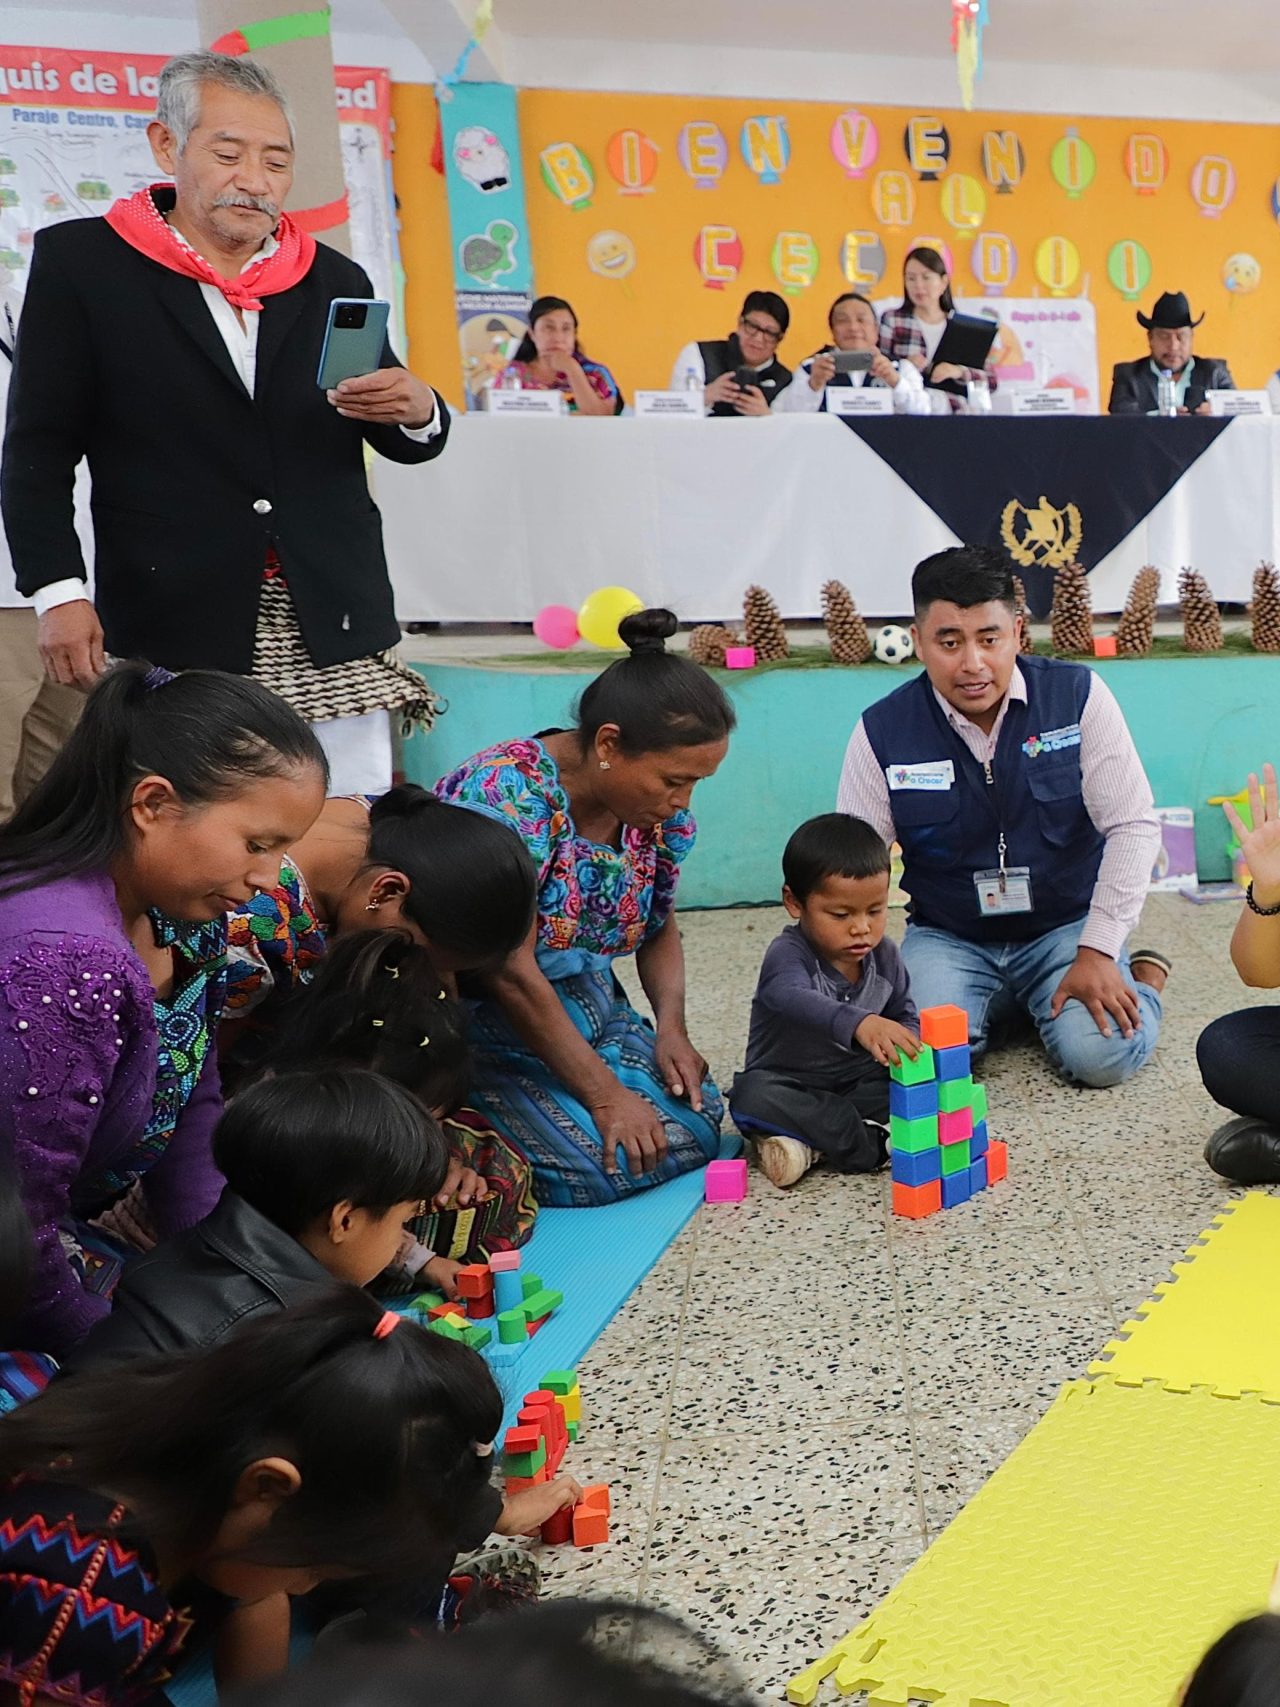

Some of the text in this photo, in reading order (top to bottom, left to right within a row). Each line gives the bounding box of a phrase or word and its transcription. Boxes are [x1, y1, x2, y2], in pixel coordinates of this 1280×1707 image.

[69, 63, 118, 95] de
[125, 66, 161, 97] la
[12, 108, 60, 125] Paraje
[872, 171, 985, 228] AL
[698, 224, 1139, 293] CECDII
